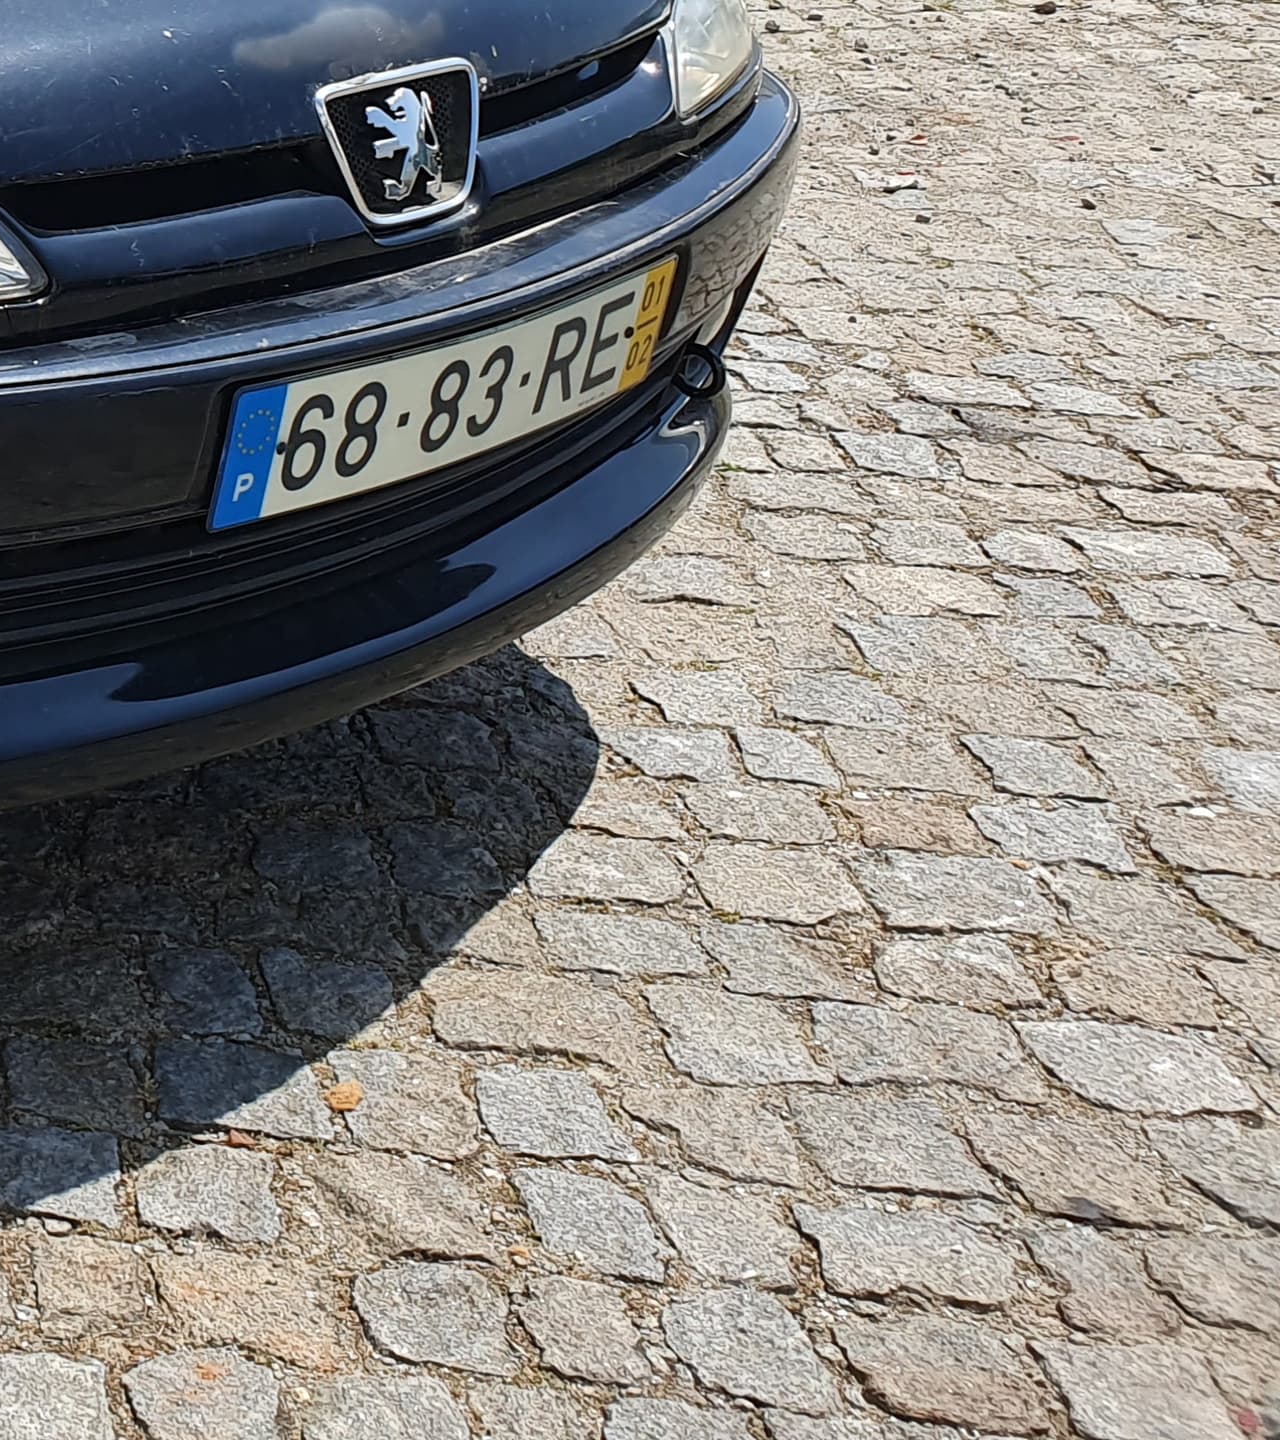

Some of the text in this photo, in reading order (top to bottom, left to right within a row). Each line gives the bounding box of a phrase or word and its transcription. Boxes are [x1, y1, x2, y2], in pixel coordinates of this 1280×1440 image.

[642, 275, 665, 312] 01
[626, 334, 652, 371] 02
[232, 472, 254, 502] P
